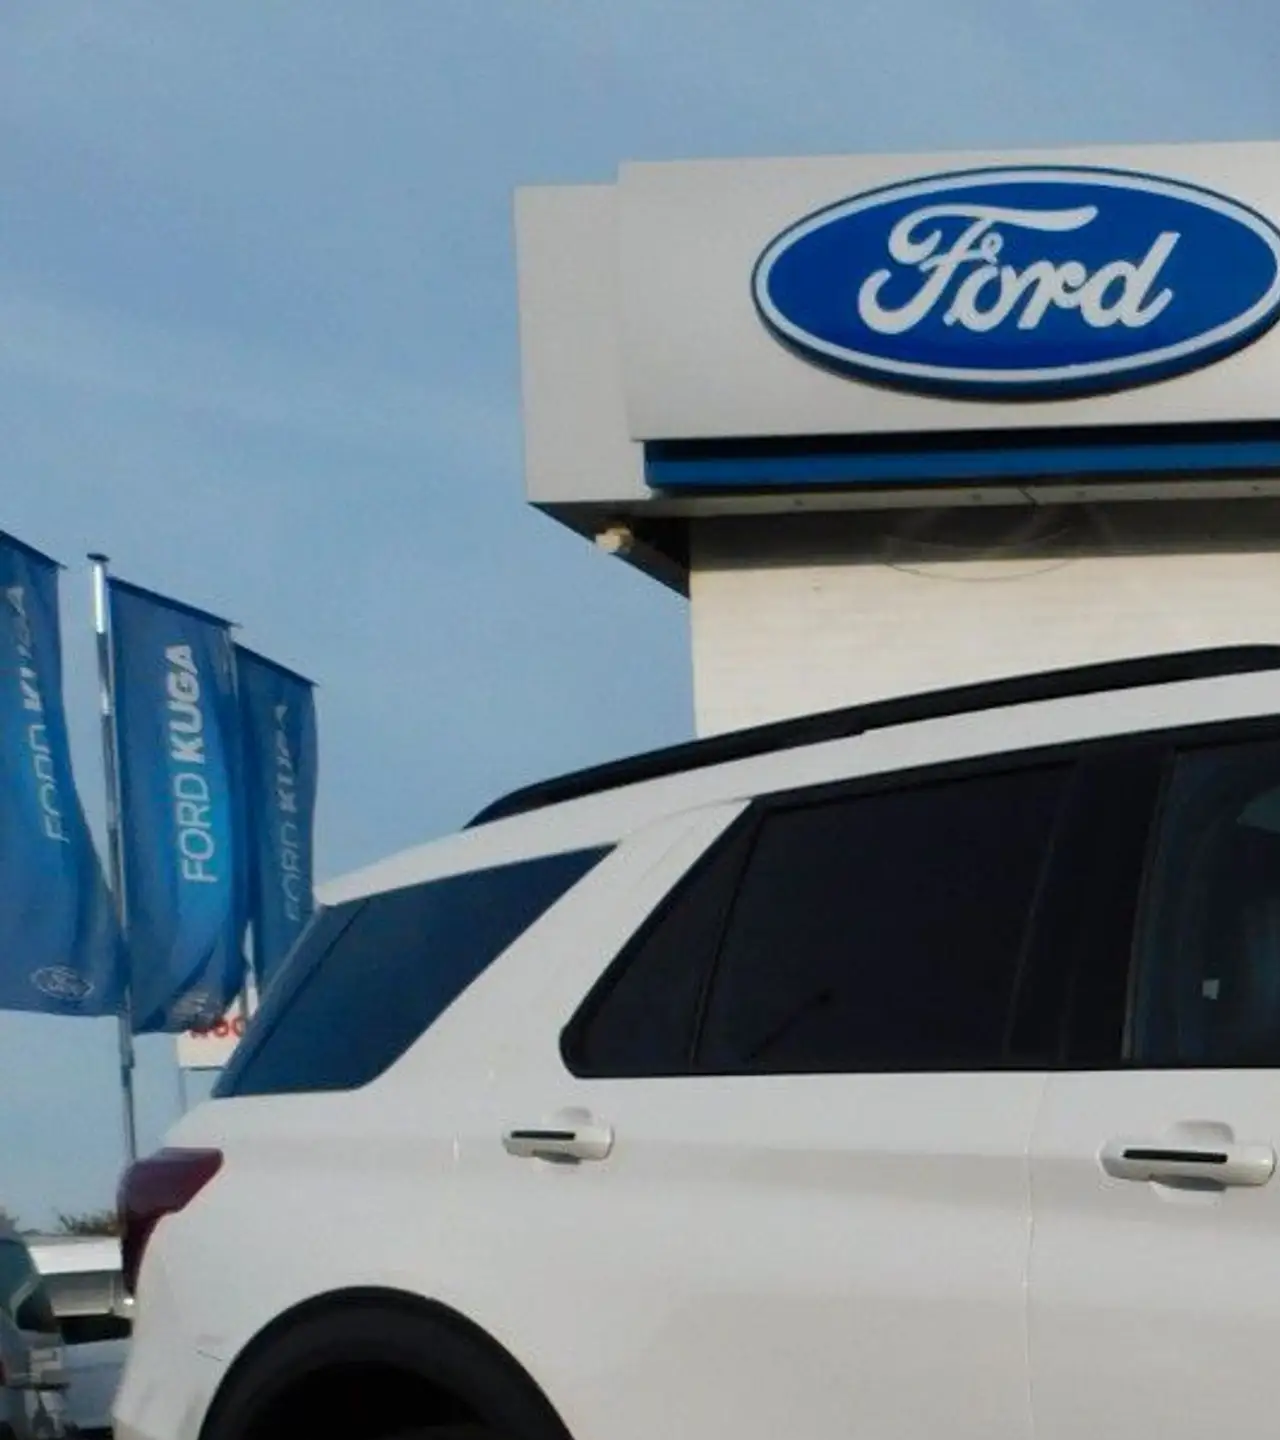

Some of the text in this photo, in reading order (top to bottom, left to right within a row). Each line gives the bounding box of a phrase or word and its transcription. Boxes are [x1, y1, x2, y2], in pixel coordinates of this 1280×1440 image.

[858, 204, 1181, 335] Ford
[165, 645, 219, 883] FORD KUGA
